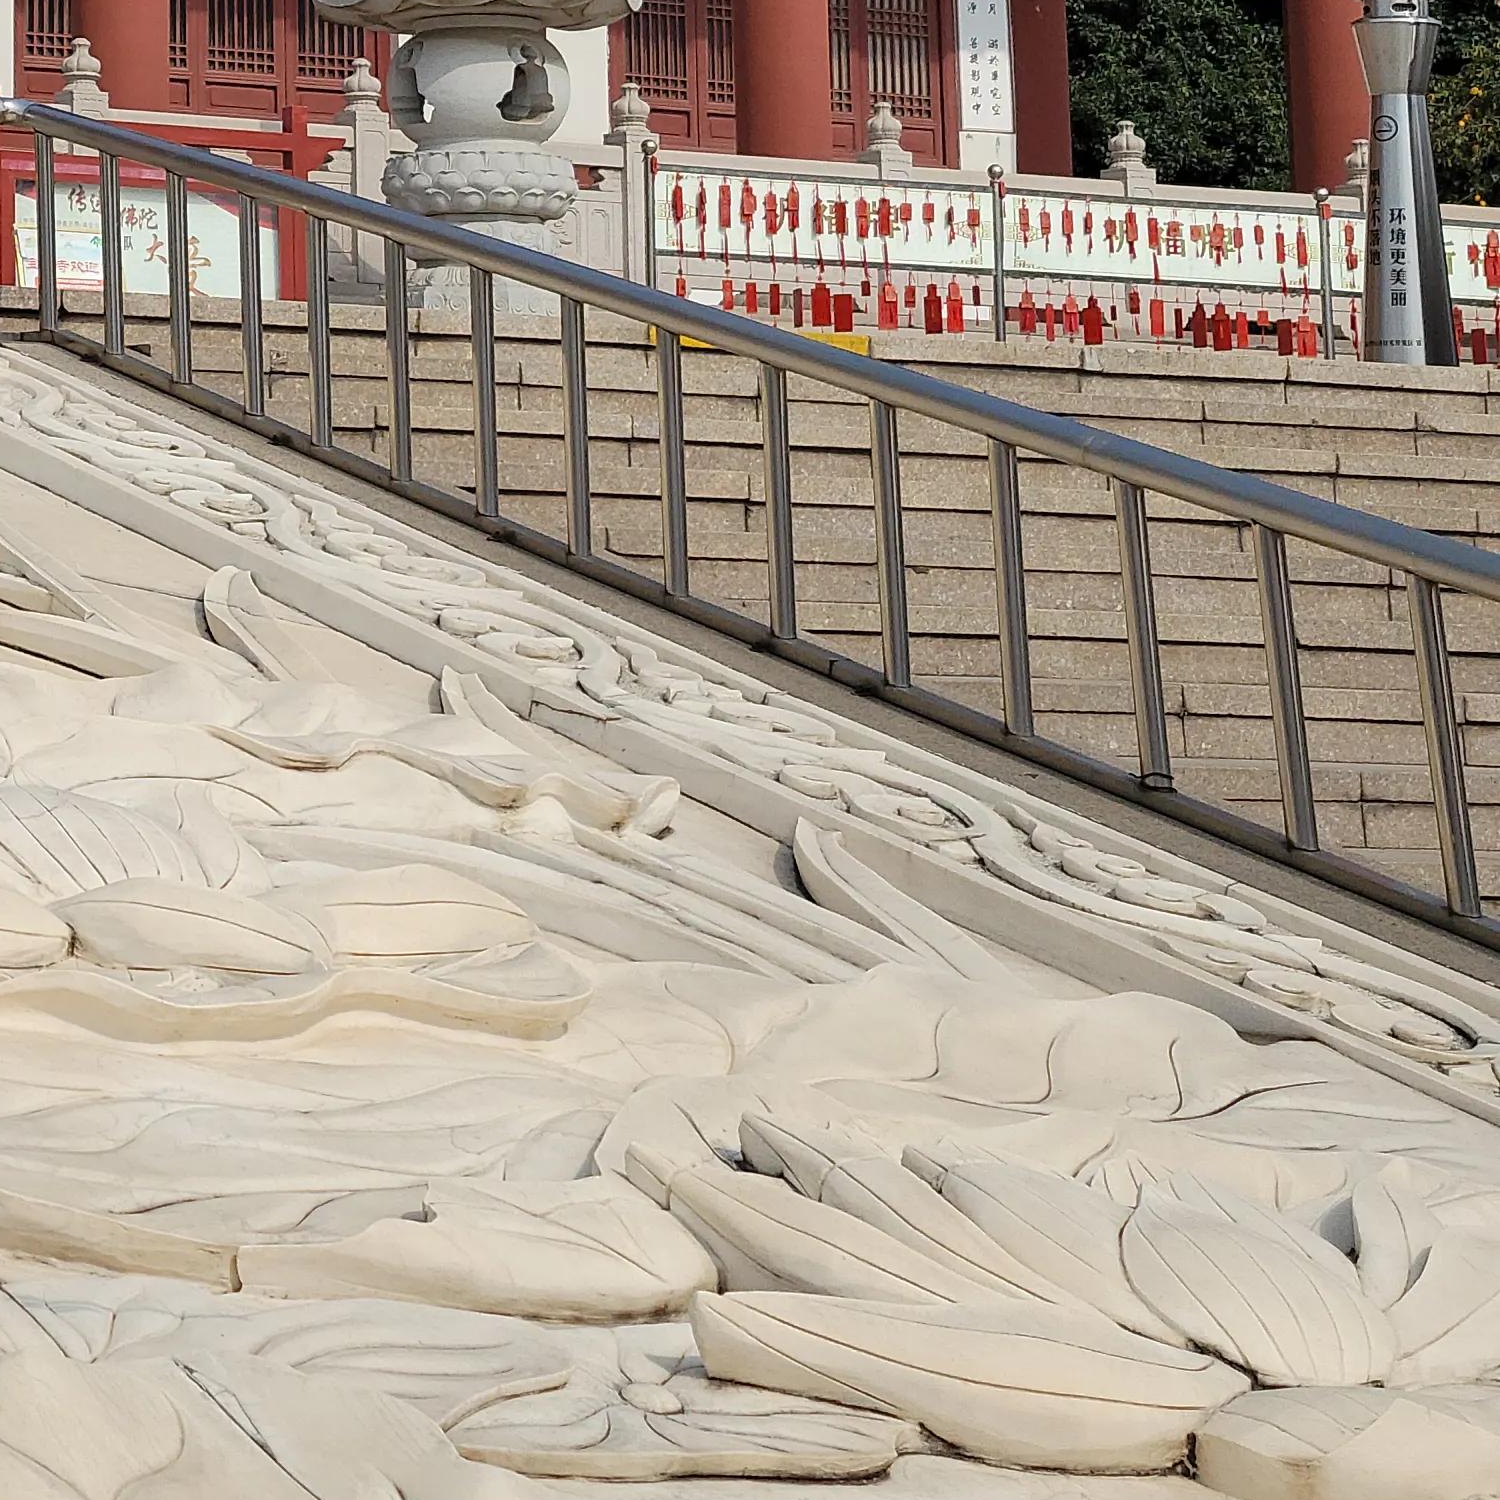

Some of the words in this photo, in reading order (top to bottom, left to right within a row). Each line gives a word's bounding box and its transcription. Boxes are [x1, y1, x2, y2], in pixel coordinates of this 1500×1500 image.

[1389, 207, 1407, 307] 环境更美丽
